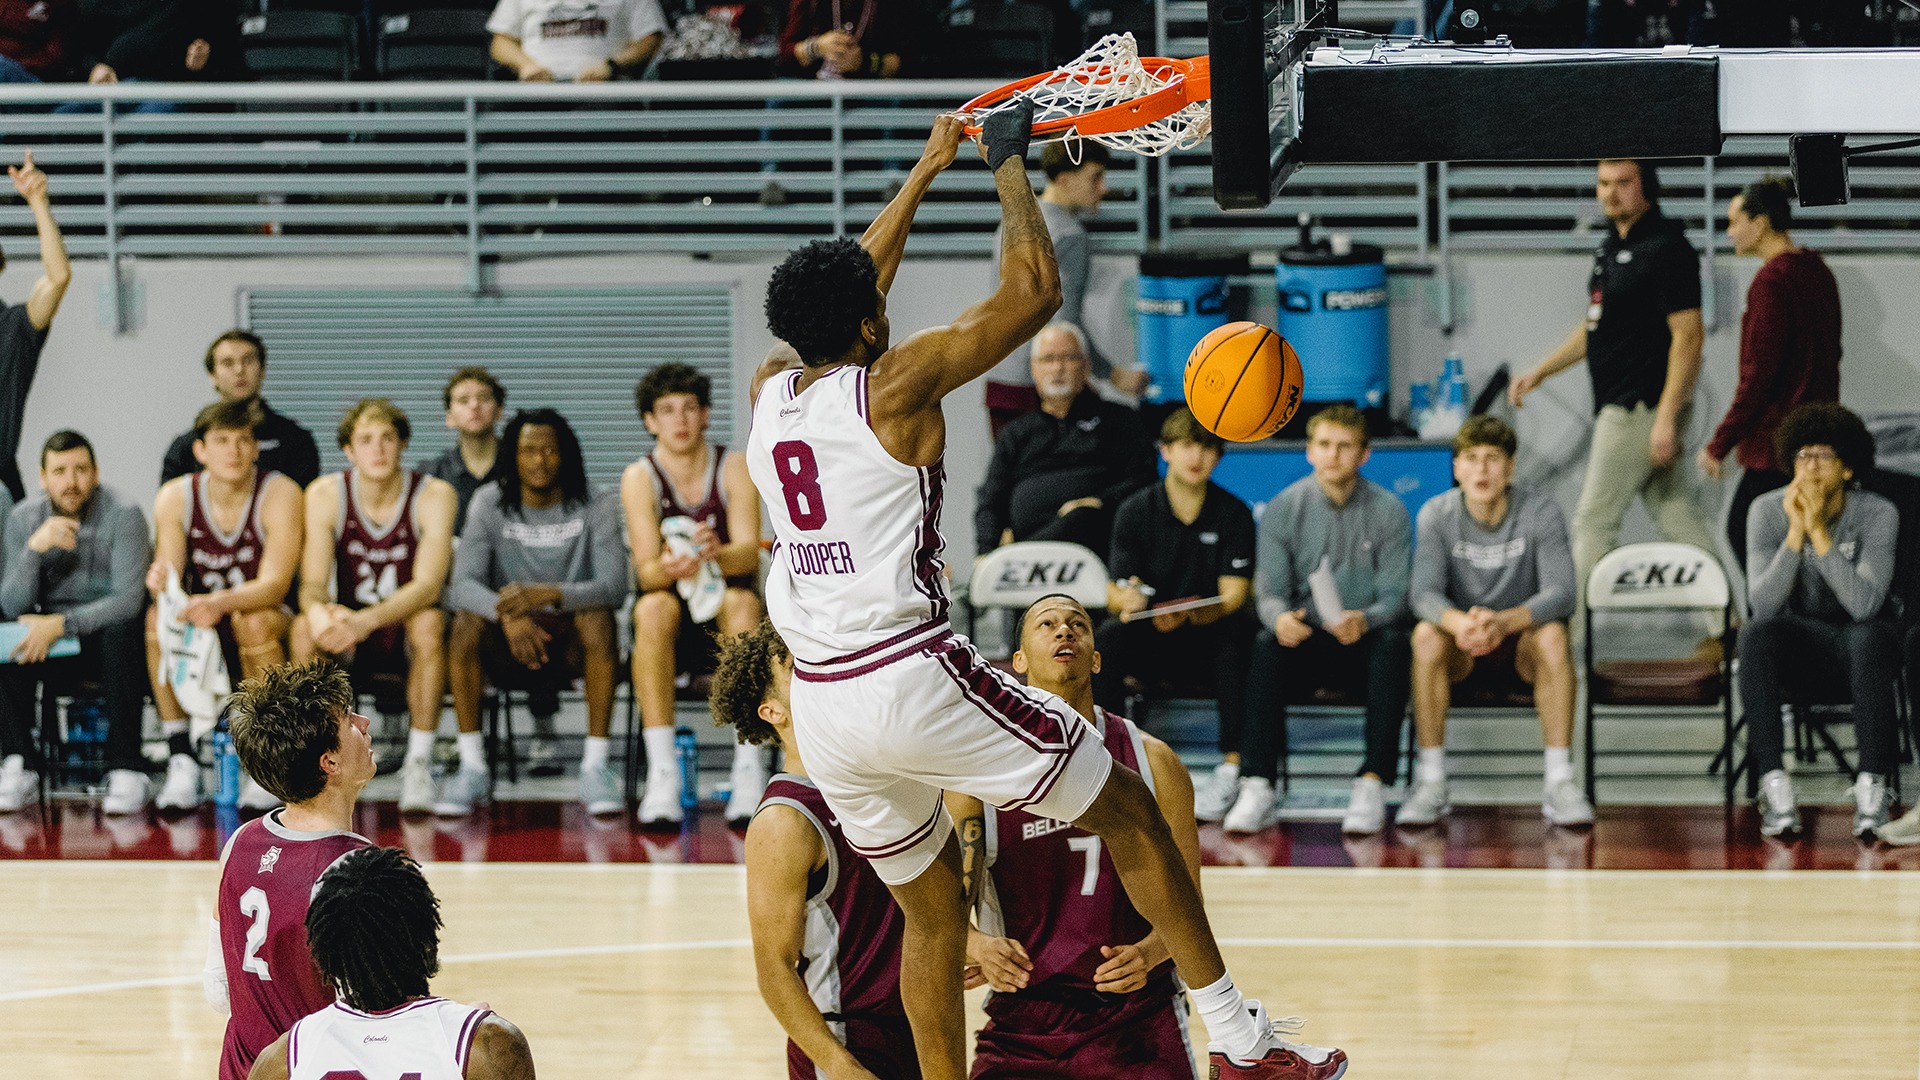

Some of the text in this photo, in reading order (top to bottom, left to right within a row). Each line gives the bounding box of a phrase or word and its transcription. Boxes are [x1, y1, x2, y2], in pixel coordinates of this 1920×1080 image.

[772, 440, 827, 531] 8
[789, 541, 856, 575] COOPER
[998, 561, 1084, 585] EKU
[1615, 563, 1703, 588] EKU
[354, 561, 398, 604] 24
[1067, 835, 1101, 896] 7
[240, 886, 272, 981] 2
